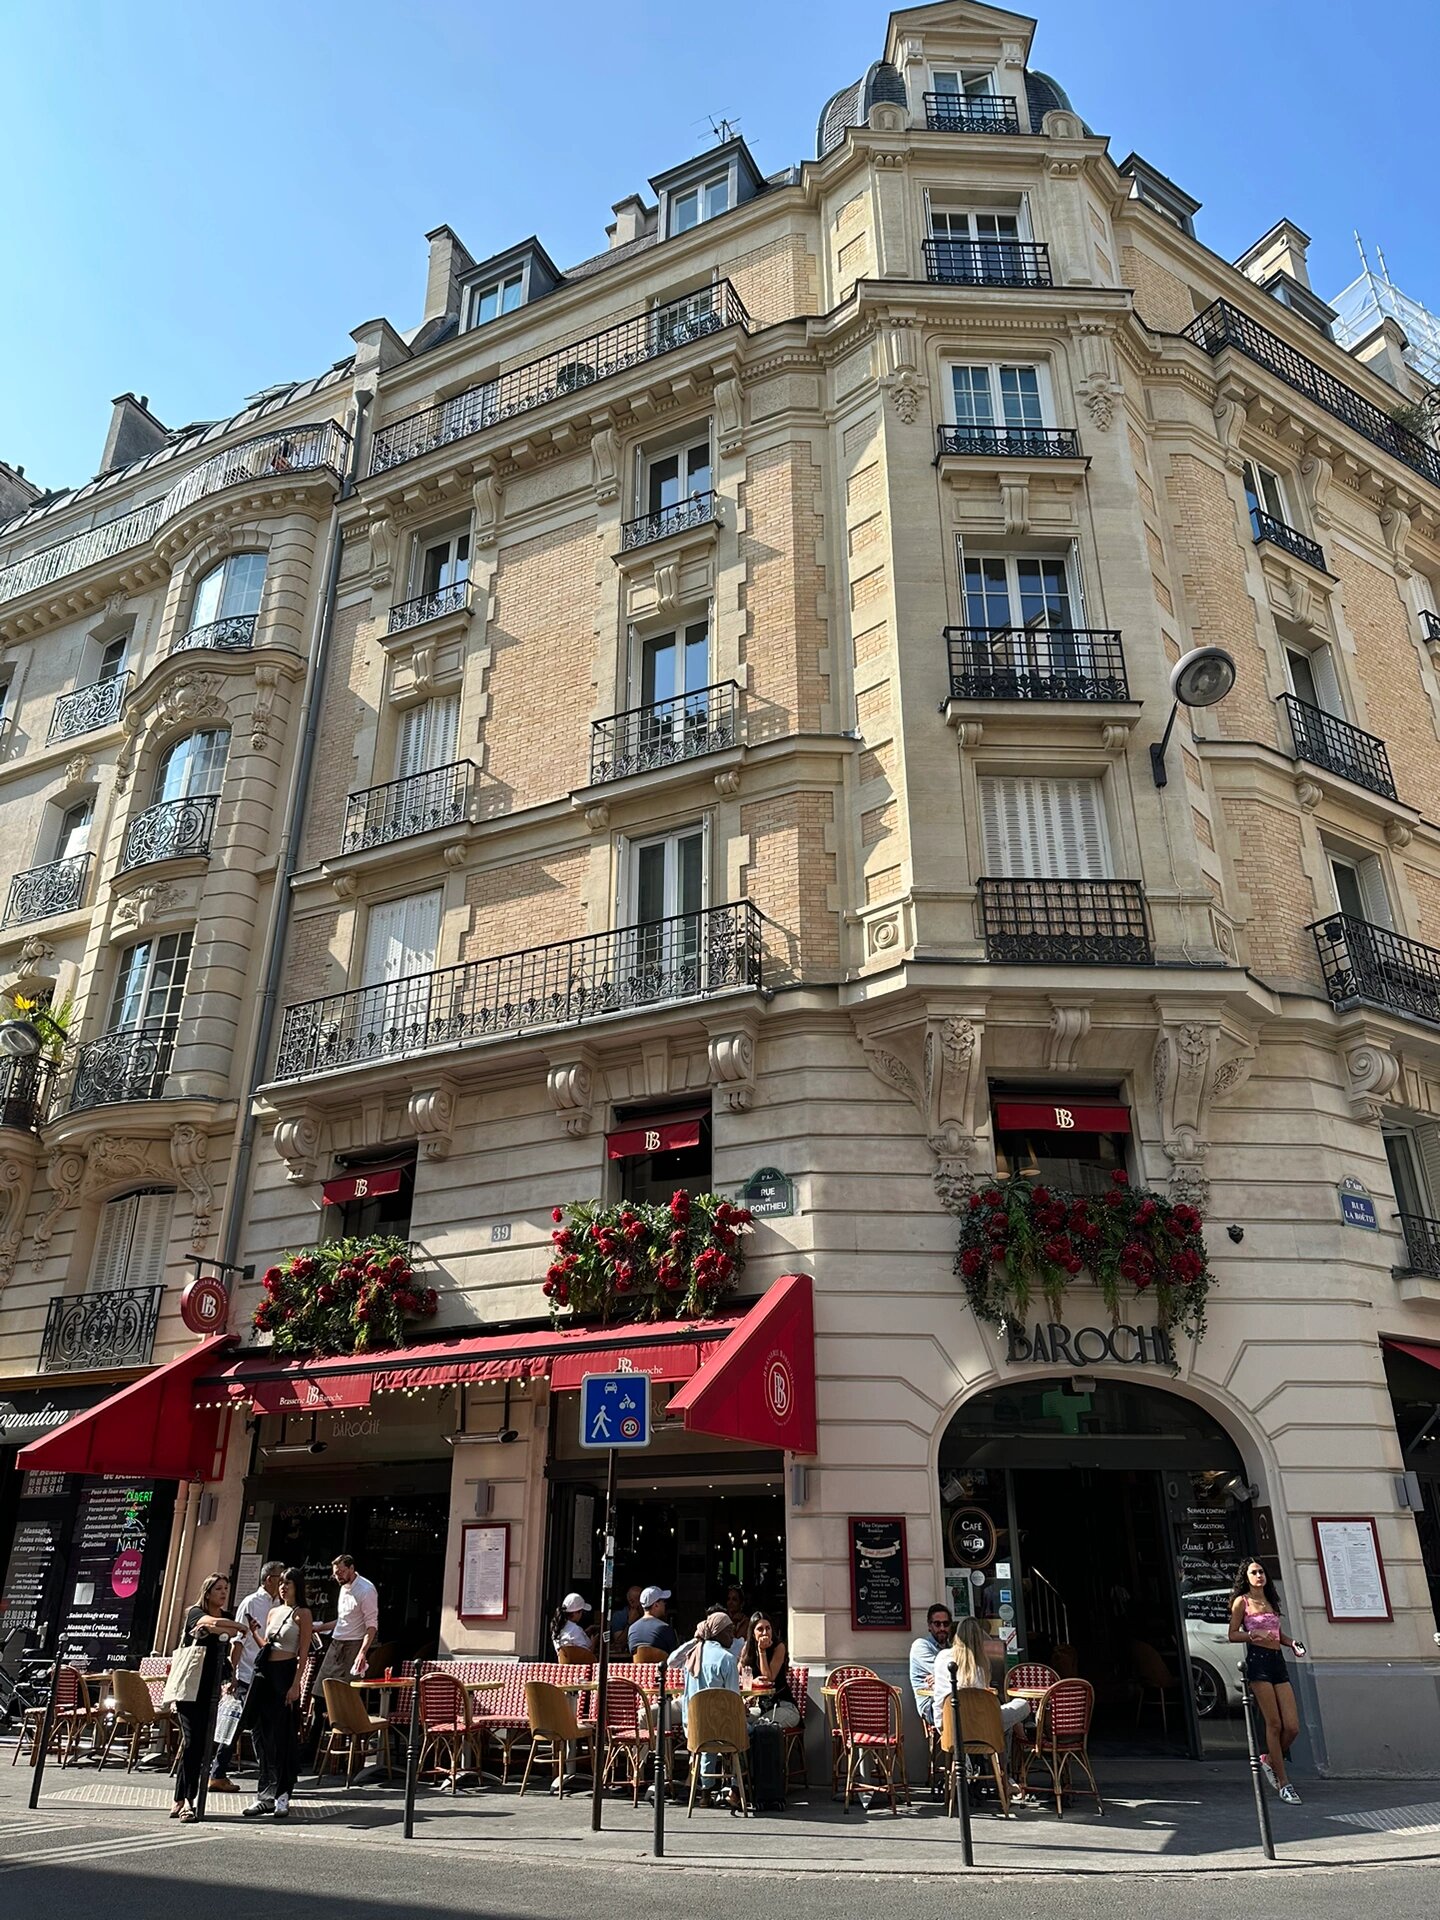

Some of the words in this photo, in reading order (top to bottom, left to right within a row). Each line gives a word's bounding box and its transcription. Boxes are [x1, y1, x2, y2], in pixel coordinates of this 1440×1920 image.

[760, 1187, 776, 1197] RUE
[750, 1201, 787, 1213] PONTHIEU
[1350, 1201, 1366, 1211] RUE
[1344, 1210, 1355, 1220] LA
[493, 1225, 509, 1241] 39
[279, 1396, 306, 1406] Brasserie
[319, 1393, 344, 1403] Baroche
[332, 1420, 381, 1438] BAROCHE
[624, 1423, 636, 1432] 20
[126, 1491, 154, 1502] OUVERT
[961, 1521, 983, 1532] CAFÉ
[1192, 1522, 1226, 1530] SUGGESTIONS
[34, 1536, 53, 1545] visage
[116, 1537, 147, 1553] NAILS
[20, 1545, 36, 1553] corps
[114, 1568, 122, 1576] de
[68, 1611, 82, 1619] Soins
[82, 1612, 98, 1620] visage
[104, 1613, 119, 1621] corps
[67, 1624, 92, 1632] Massages
[68, 1644, 83, 1652] Pose
